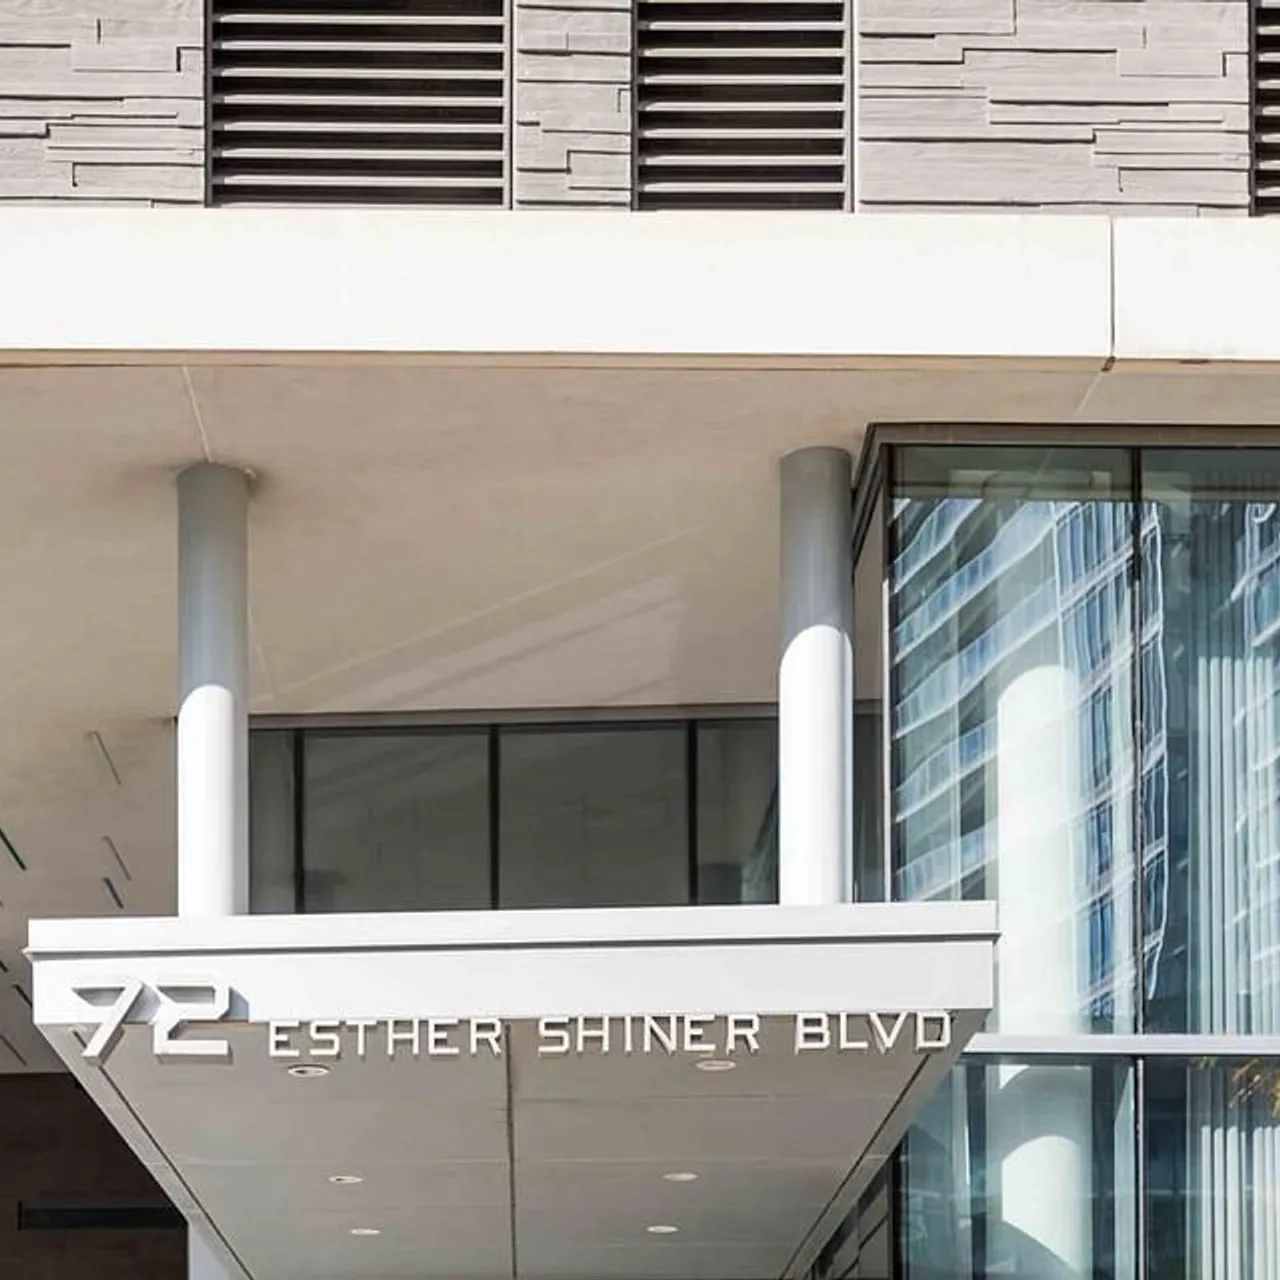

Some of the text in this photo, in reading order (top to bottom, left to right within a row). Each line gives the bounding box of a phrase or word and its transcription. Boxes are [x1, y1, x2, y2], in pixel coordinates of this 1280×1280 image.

[72, 979, 952, 1058] 72 ESTHER SHINER BLVD
